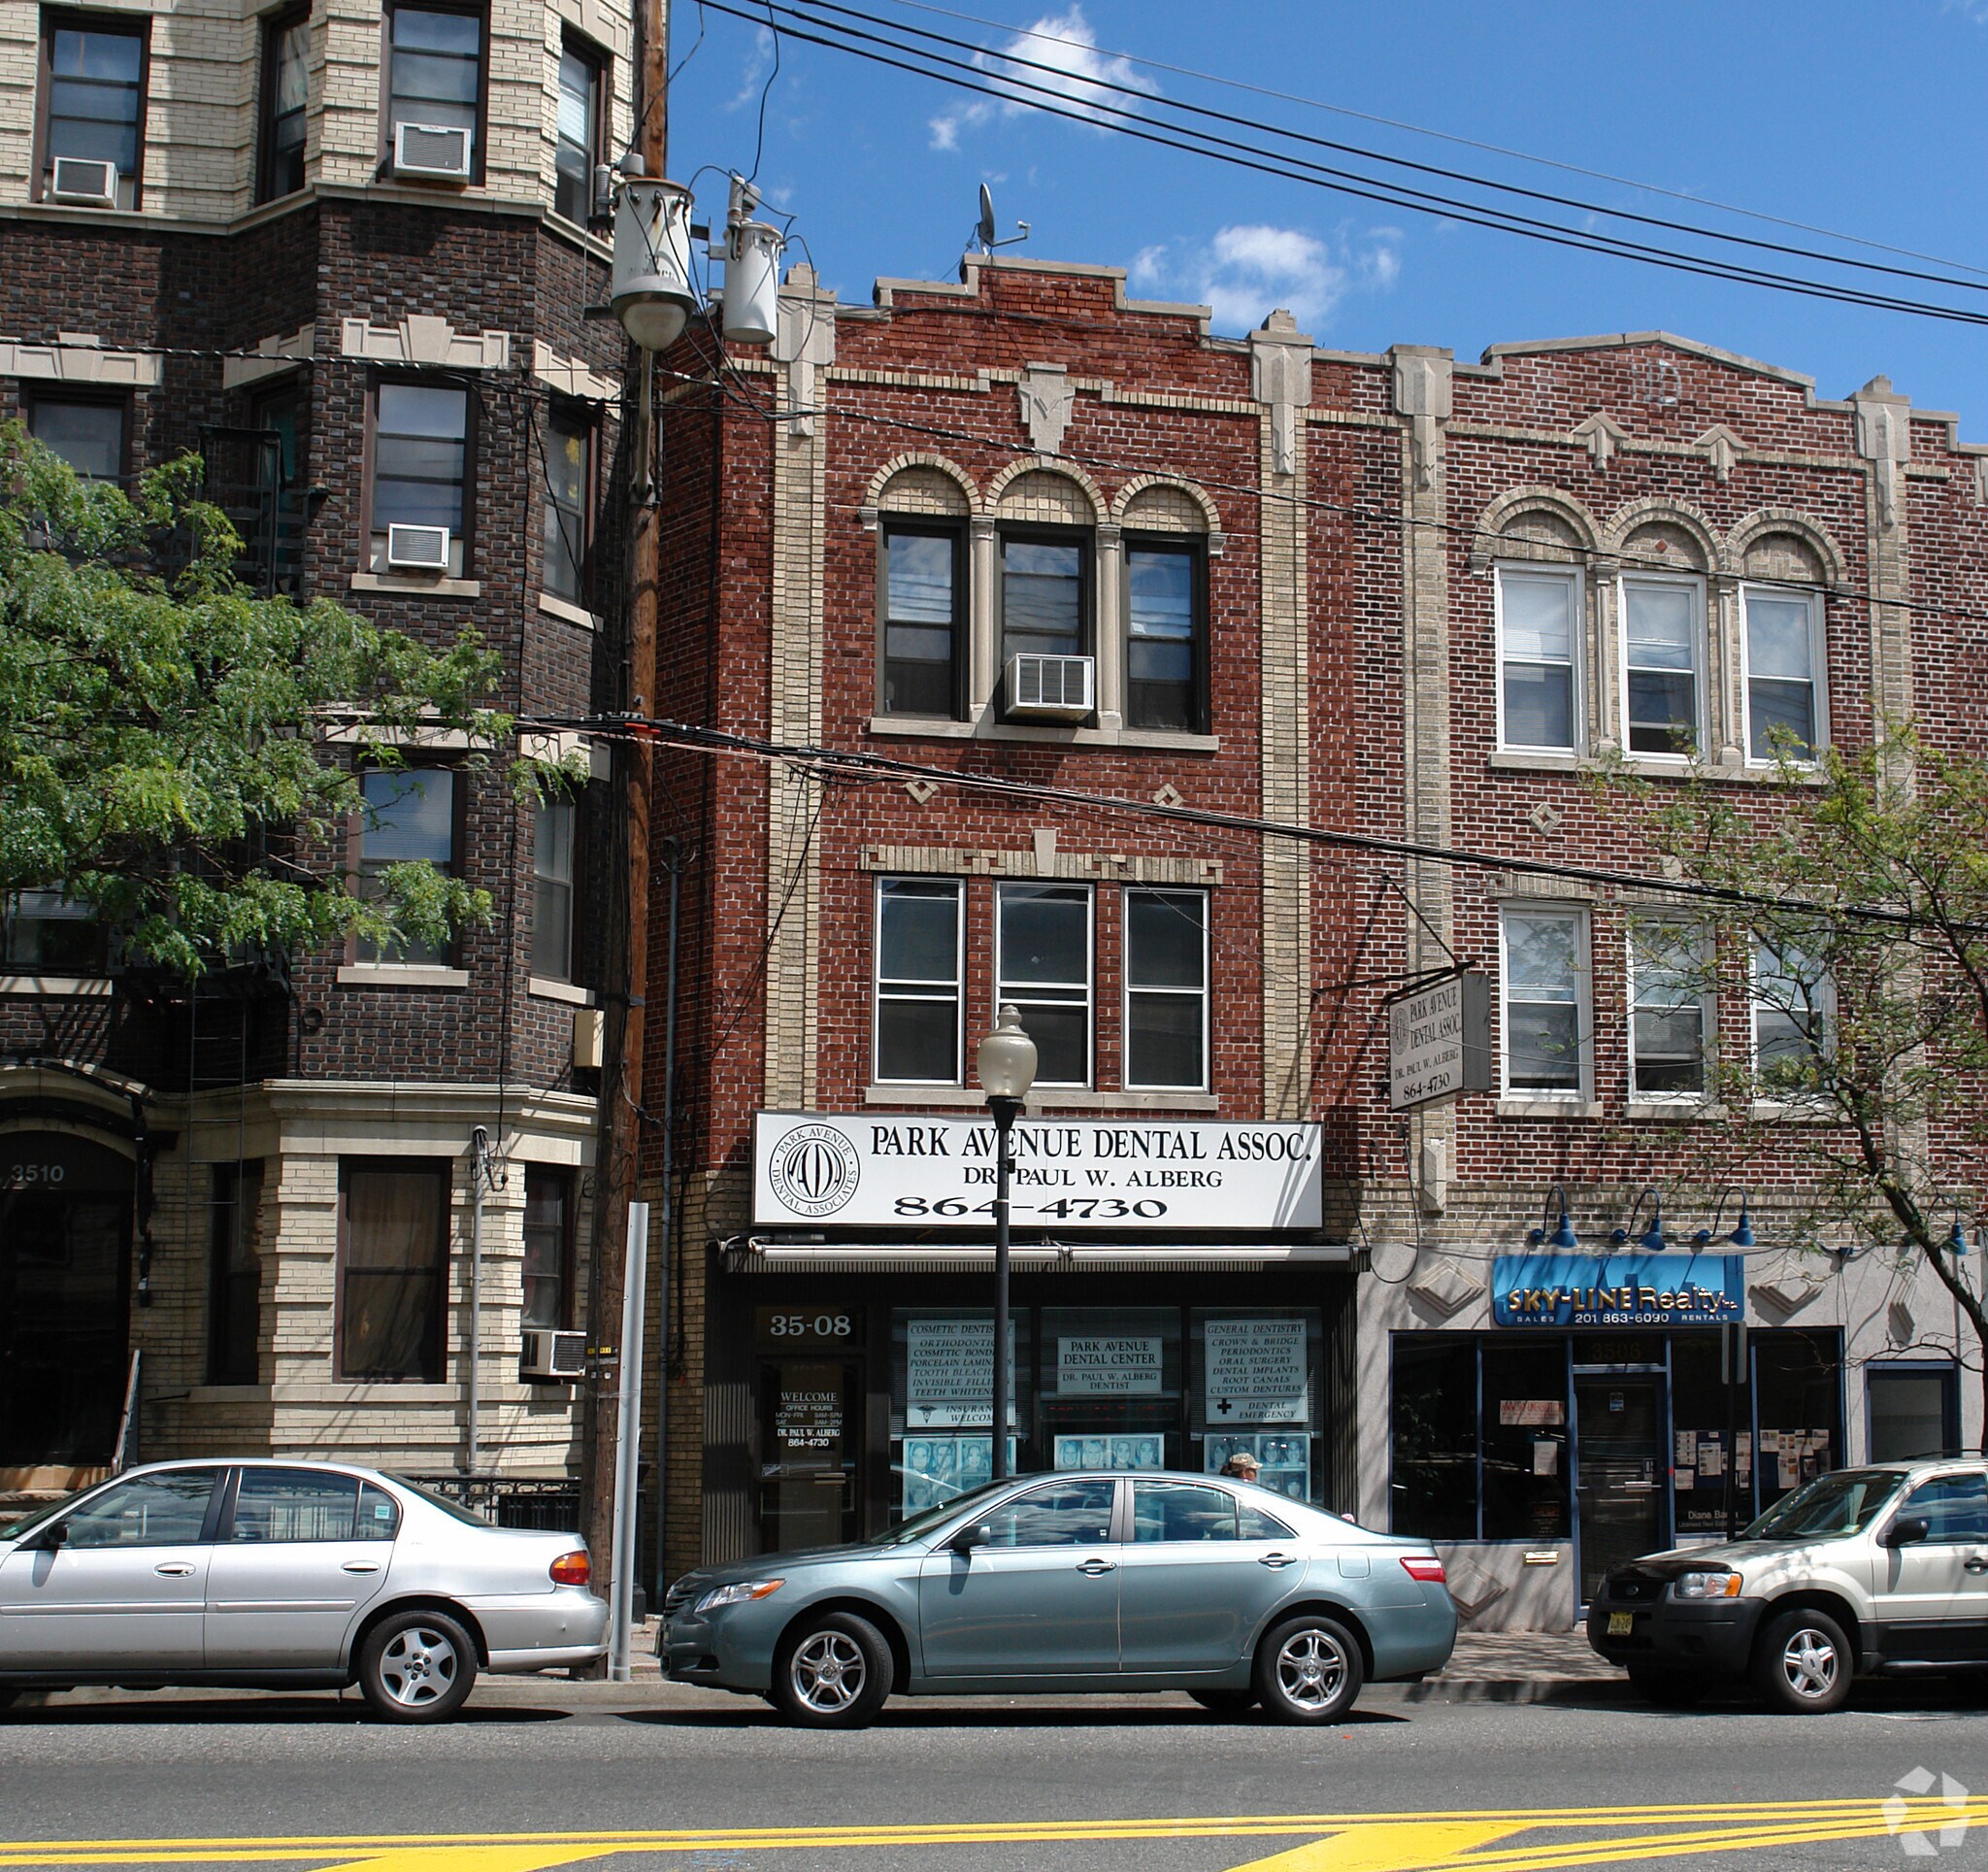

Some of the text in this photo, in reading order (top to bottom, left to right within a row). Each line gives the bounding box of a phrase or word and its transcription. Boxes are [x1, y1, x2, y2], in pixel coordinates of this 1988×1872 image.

[1409, 986, 1458, 1022] PARK AVENUE
[1410, 1022, 1437, 1050] DENTAL
[1438, 1013, 1462, 1037] ASSOC.
[1394, 1049, 1458, 1081] DR. PAUL W. ALBERG
[1404, 1072, 1450, 1101] 864-4730
[779, 1128, 852, 1155] PARK AVENUE
[871, 1126, 1312, 1161] PARK AVENUE DENTAL ASSOC.
[11, 1164, 64, 1183] 3510
[1015, 1169, 1076, 1187] PAUL
[1085, 1170, 1115, 1187] W.
[1126, 1171, 1223, 1187] ALBERG
[773, 1169, 856, 1214] DENTAL ASSOCIATES
[894, 1196, 1168, 1219] 864-4730
[1508, 1287, 1632, 1311] SKY-LINE
[1639, 1286, 1725, 1313] Realty
[770, 1315, 851, 1336] 35-08
[1574, 1314, 1598, 1324] 201
[1603, 1313, 1670, 1323] 863-6090
[911, 1324, 957, 1334] COSMETIC
[1208, 1324, 1303, 1334] GENERAL DENTISTRY
[1072, 1341, 1149, 1352] PARK AVENUE
[1064, 1354, 1155, 1364] DENTAL CENTER
[780, 1391, 838, 1402] WELCOME
[1239, 1410, 1297, 1420] EMERGENCY
[777, 1428, 788, 1437] DR.
[789, 1428, 806, 1437] PAUL
[806, 1428, 815, 1437] W.
[788, 1438, 829, 1447] 864-4730
[1687, 1510, 1711, 1520] Diane
